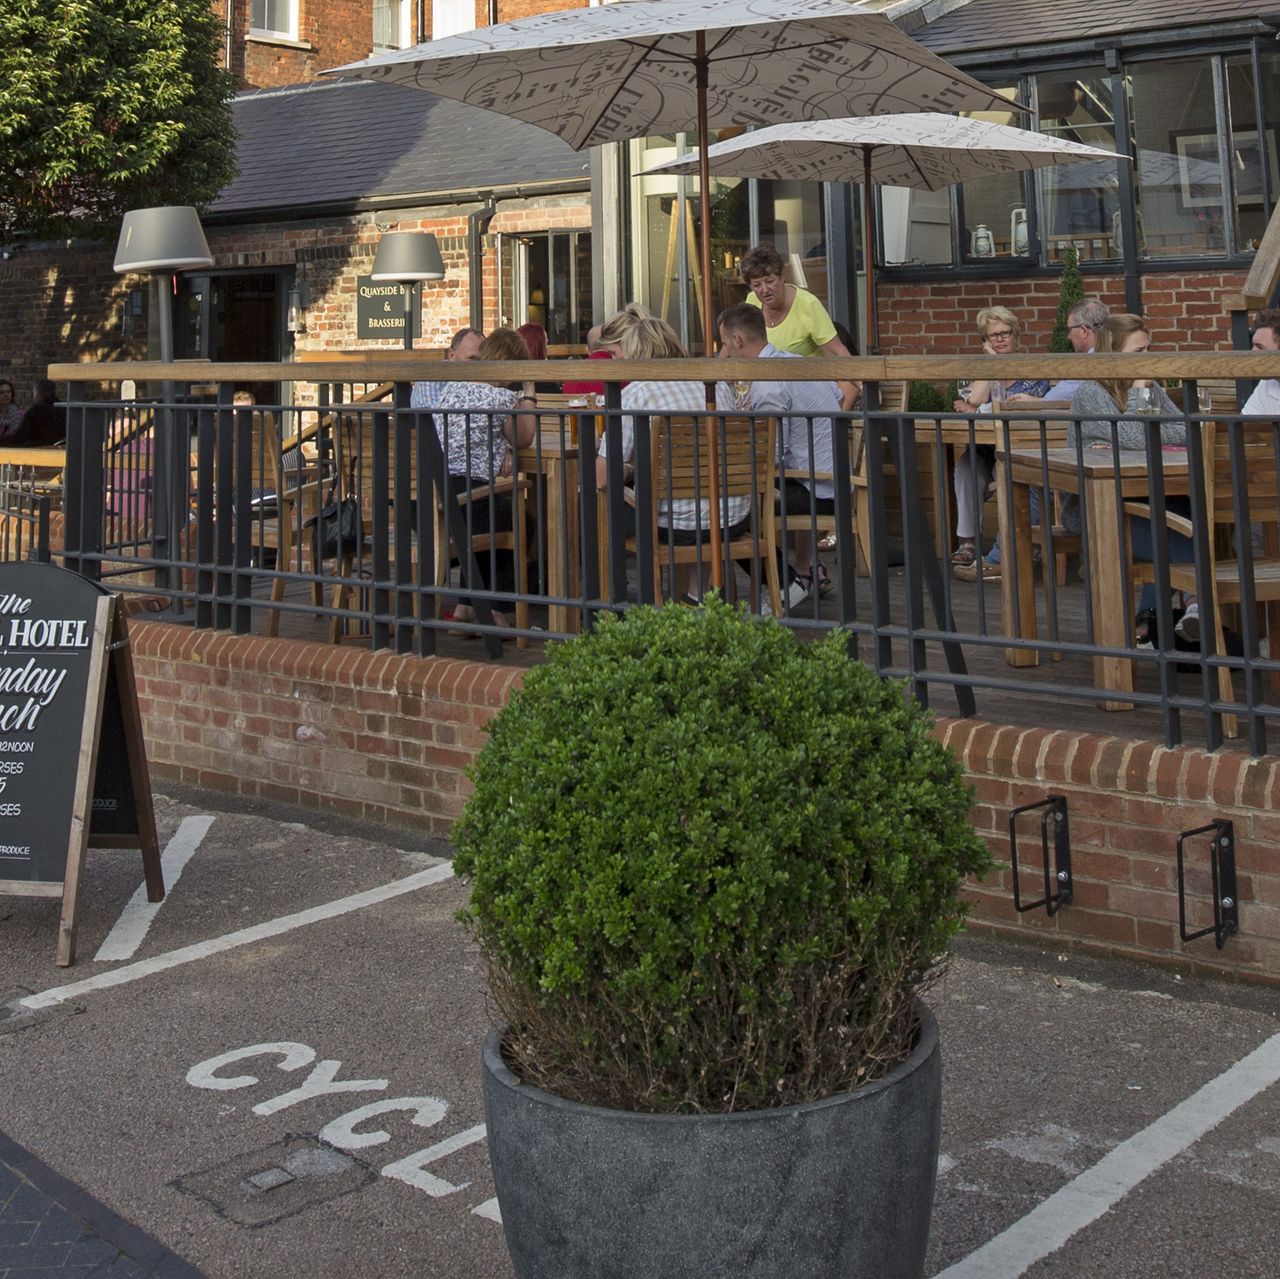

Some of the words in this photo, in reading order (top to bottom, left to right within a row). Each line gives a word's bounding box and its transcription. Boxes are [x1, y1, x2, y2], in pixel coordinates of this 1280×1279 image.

[360, 286, 397, 298] QUAYSIDE
[383, 301, 391, 312] &
[368, 318, 405, 328] BRASSERI
[8, 619, 89, 648] HOTEL
[186, 1041, 503, 1223] CYCL
